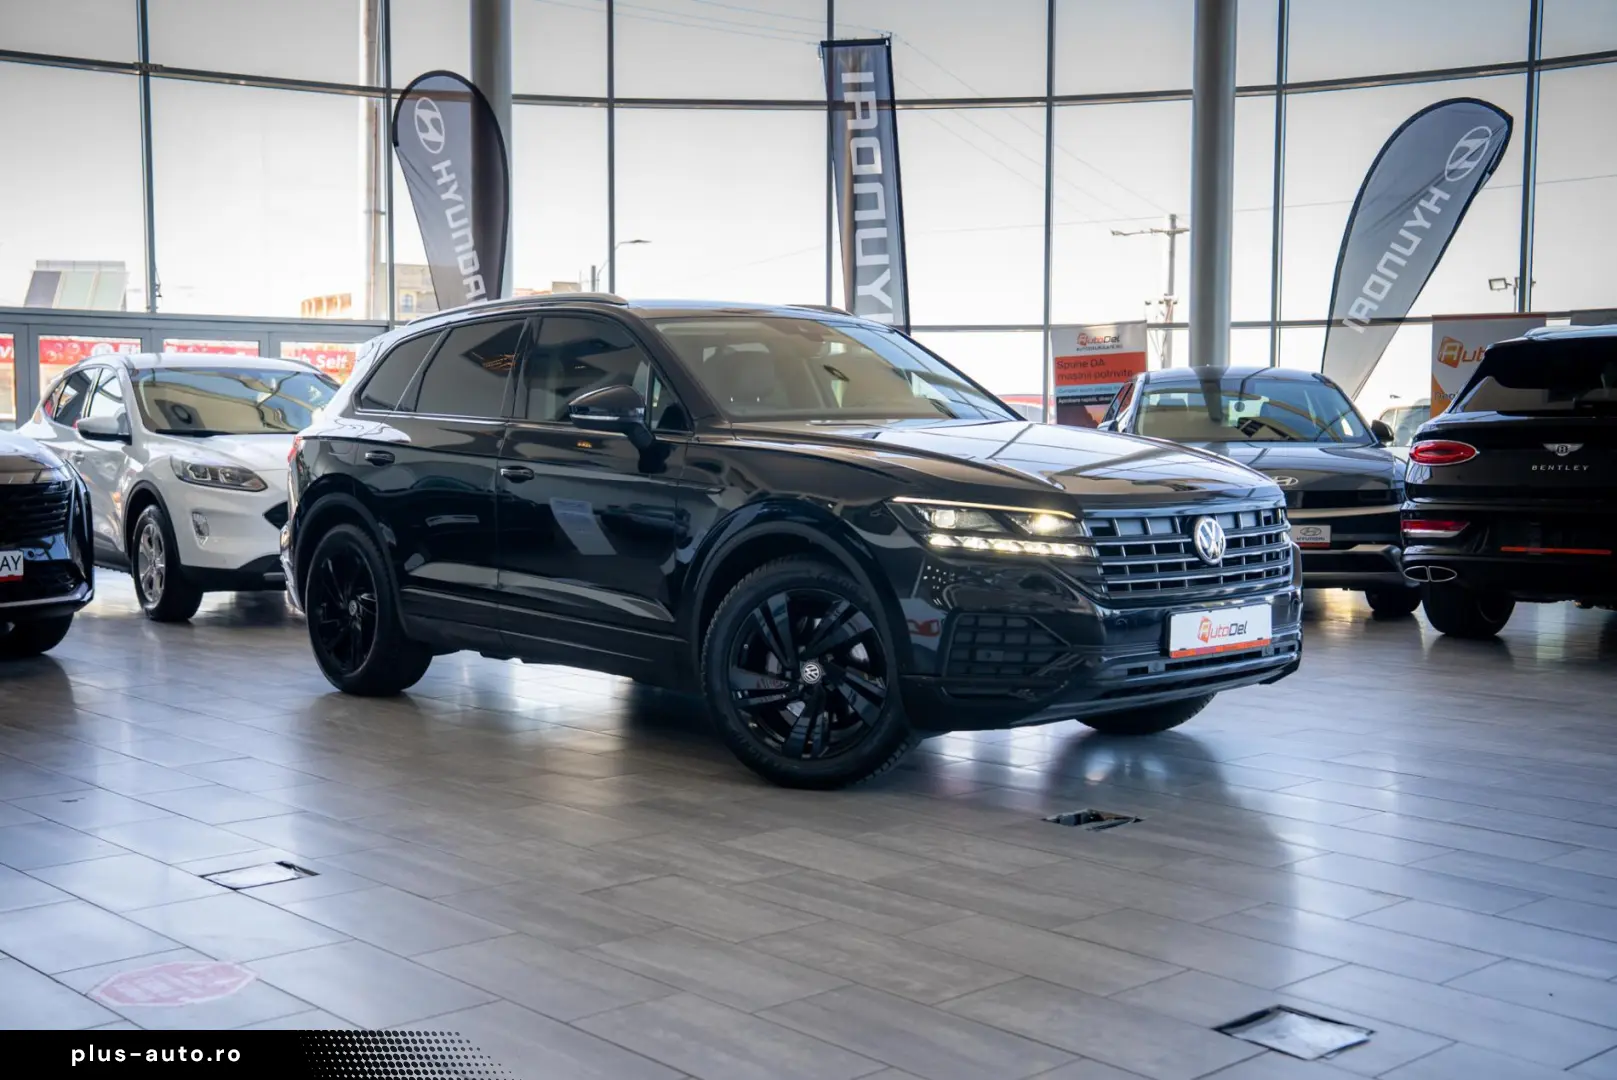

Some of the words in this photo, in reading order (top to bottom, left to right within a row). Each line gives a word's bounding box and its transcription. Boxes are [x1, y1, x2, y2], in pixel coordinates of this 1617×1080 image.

[1057, 360, 1088, 370] Spune
[1090, 358, 1105, 367] DA
[1438, 336, 1485, 368] Aut
[1197, 616, 1248, 643] AutoDel
